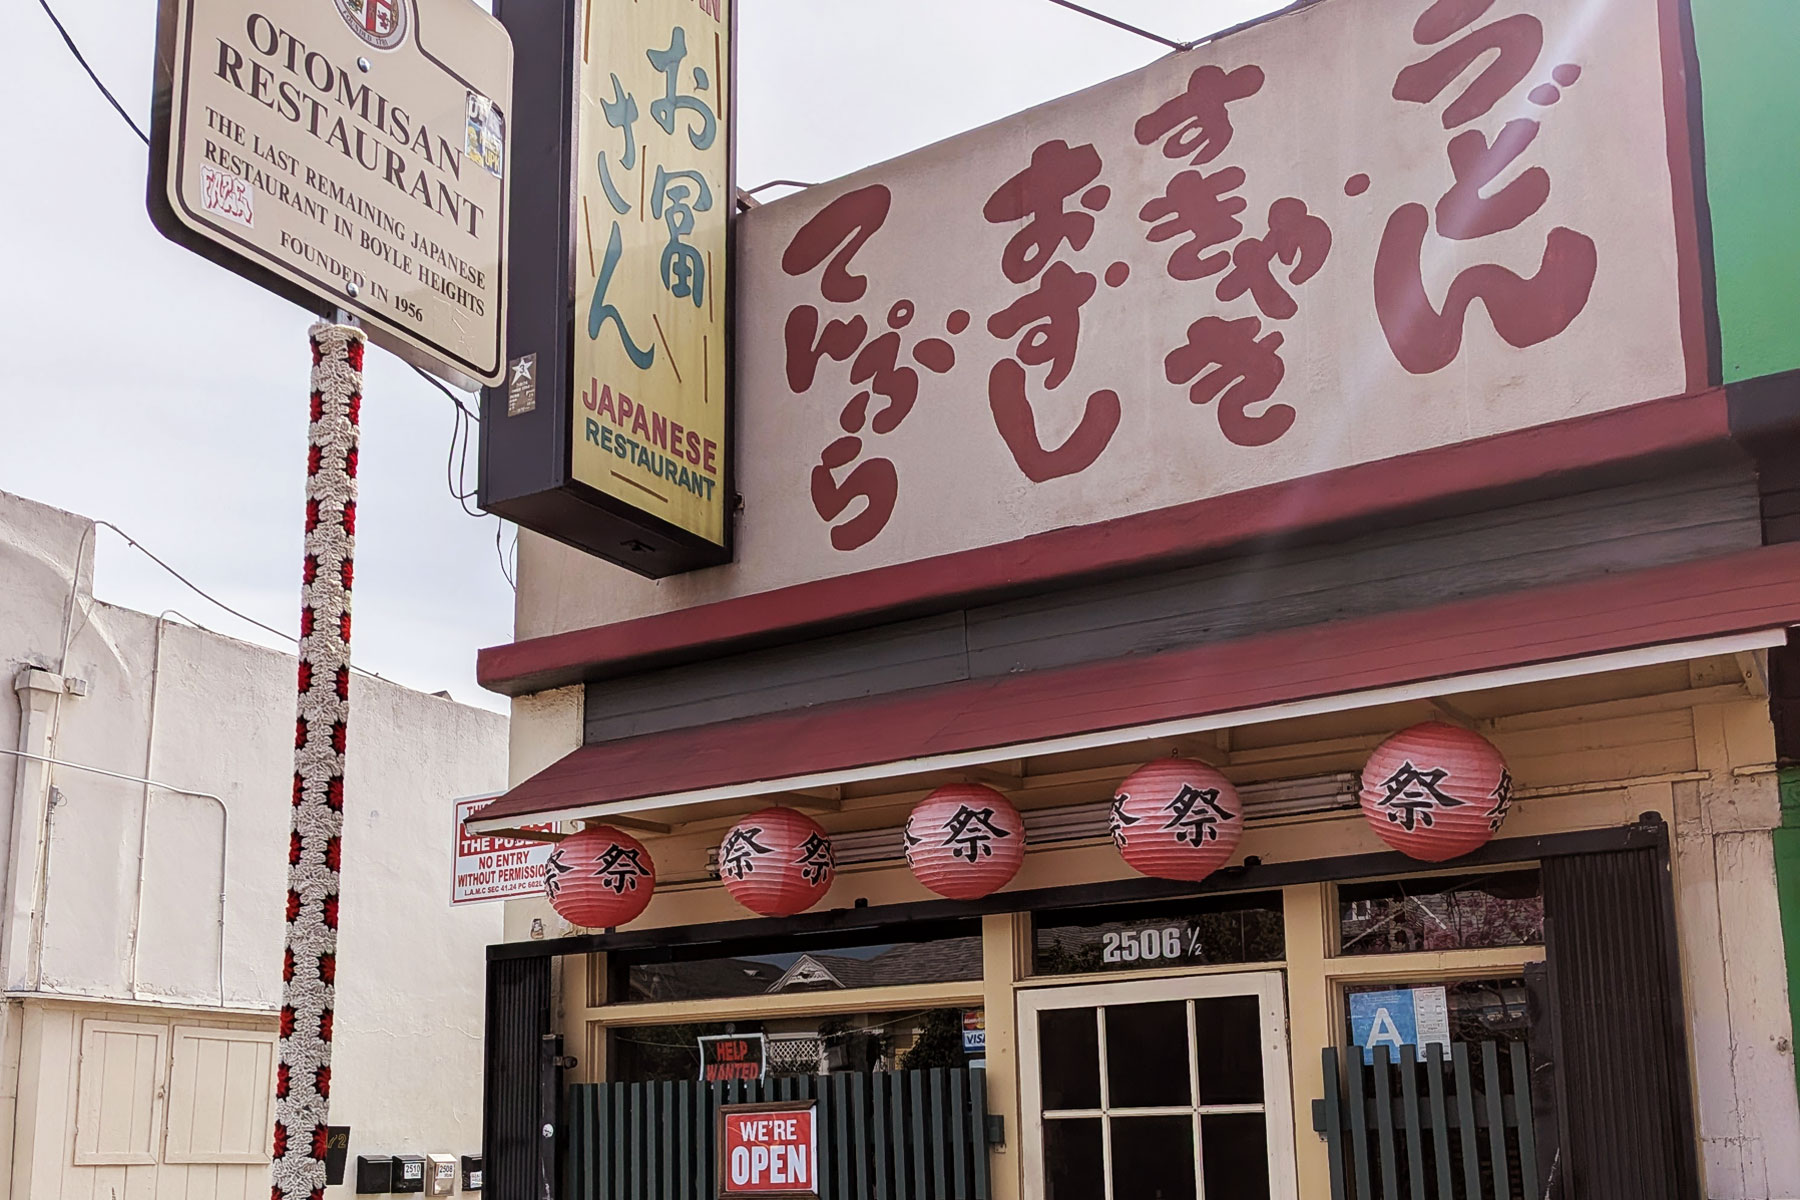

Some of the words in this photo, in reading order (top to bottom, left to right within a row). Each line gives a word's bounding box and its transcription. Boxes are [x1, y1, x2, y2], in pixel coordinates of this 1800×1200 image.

[246, 13, 463, 181] OTOMISAN
[214, 37, 484, 240] RESTAURANT
[205, 106, 246, 147] THE
[253, 134, 300, 177] LAST
[305, 165, 405, 241] REMAINING
[411, 231, 486, 290] JAPANESE
[204, 138, 329, 225] RESTAURANT
[334, 213, 354, 241] IN
[360, 229, 412, 275] BOYLE
[418, 263, 485, 317] HEIGHTS
[280, 229, 365, 288] FOUNDED
[370, 280, 389, 304] IN
[395, 295, 423, 322] 1956
[582, 377, 717, 475] JAPANESE
[586, 416, 716, 502] RESTAURANT
[1163, 783, 1237, 848] 祭
[1377, 760, 1467, 832] 祭
[461, 838, 490, 854] THE
[722, 827, 776, 881] 祭
[942, 804, 1011, 864] 祭
[457, 870, 496, 888] WITHOUT
[498, 863, 546, 883] PERMISSIO
[478, 856, 493, 870] NO
[496, 850, 530, 868] ENTRY
[594, 842, 652, 894] 祭
[796, 831, 836, 887] 祭
[487, 885, 500, 894] SEC
[1103, 927, 1181, 963] 2506
[716, 1041, 748, 1061] HELP
[967, 1034, 985, 1044] VIS
[1365, 1007, 1404, 1050] A
[706, 1062, 759, 1081] WANTED
[740, 1119, 798, 1142] WE'RE
[405, 1164, 421, 1173] 2510
[439, 1164, 453, 1173] 2508
[731, 1144, 807, 1186] OPEN
